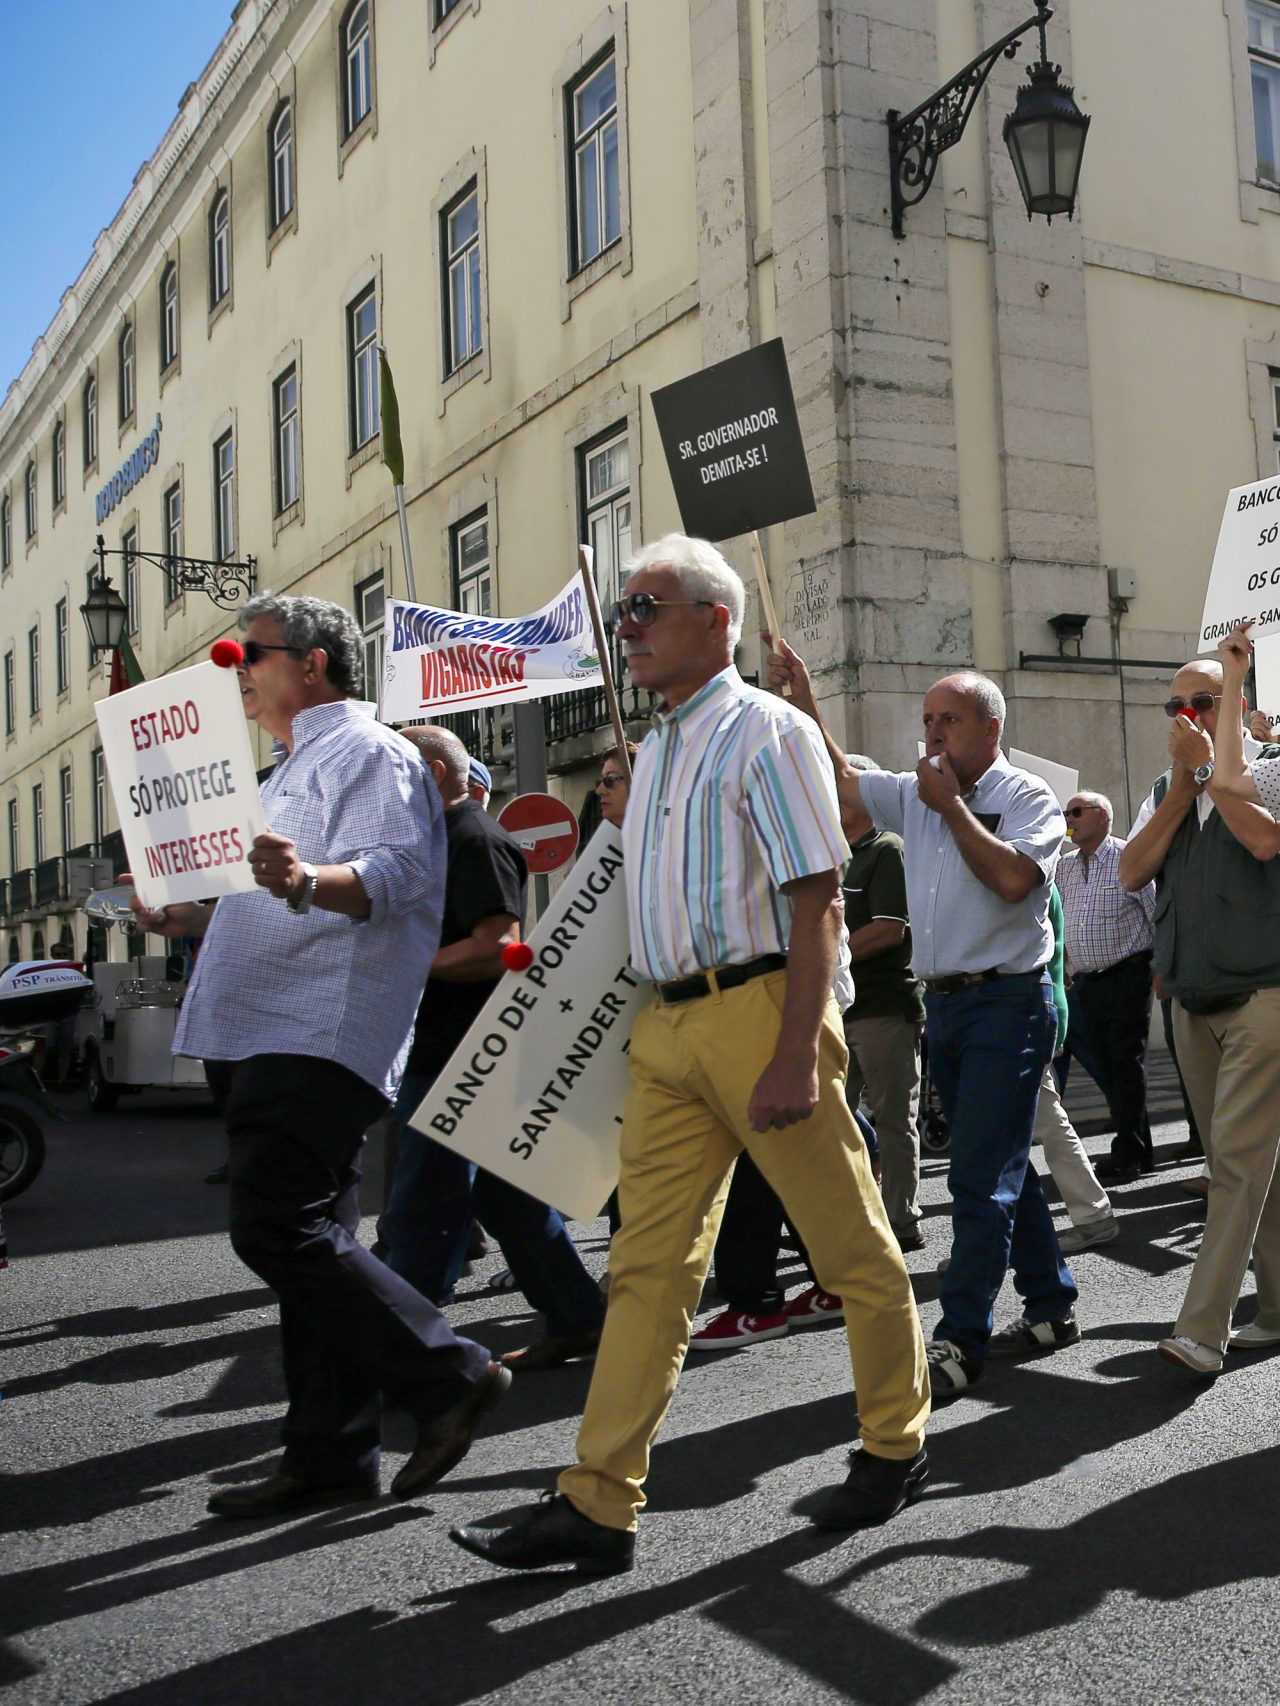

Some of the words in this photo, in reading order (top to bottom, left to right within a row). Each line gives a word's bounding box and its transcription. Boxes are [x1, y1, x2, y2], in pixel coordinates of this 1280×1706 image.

[679, 440, 697, 460] SR.
[697, 407, 779, 452] GOVERNADOR
[700, 448, 761, 484] DEMITA-SE
[1257, 522, 1278, 547] SÓ
[1247, 571, 1268, 591] OS
[421, 643, 542, 700] VIGARISTAS
[130, 700, 200, 752] ESTADO
[129, 775, 152, 818] SÓ
[152, 759, 236, 812] PROTEGE
[145, 827, 245, 879] INTERESSES
[12, 975, 40, 989] PSP
[430, 1033, 508, 1136] BANCO
[498, 987, 538, 1031] DE
[509, 991, 627, 1160] SANTANDER
